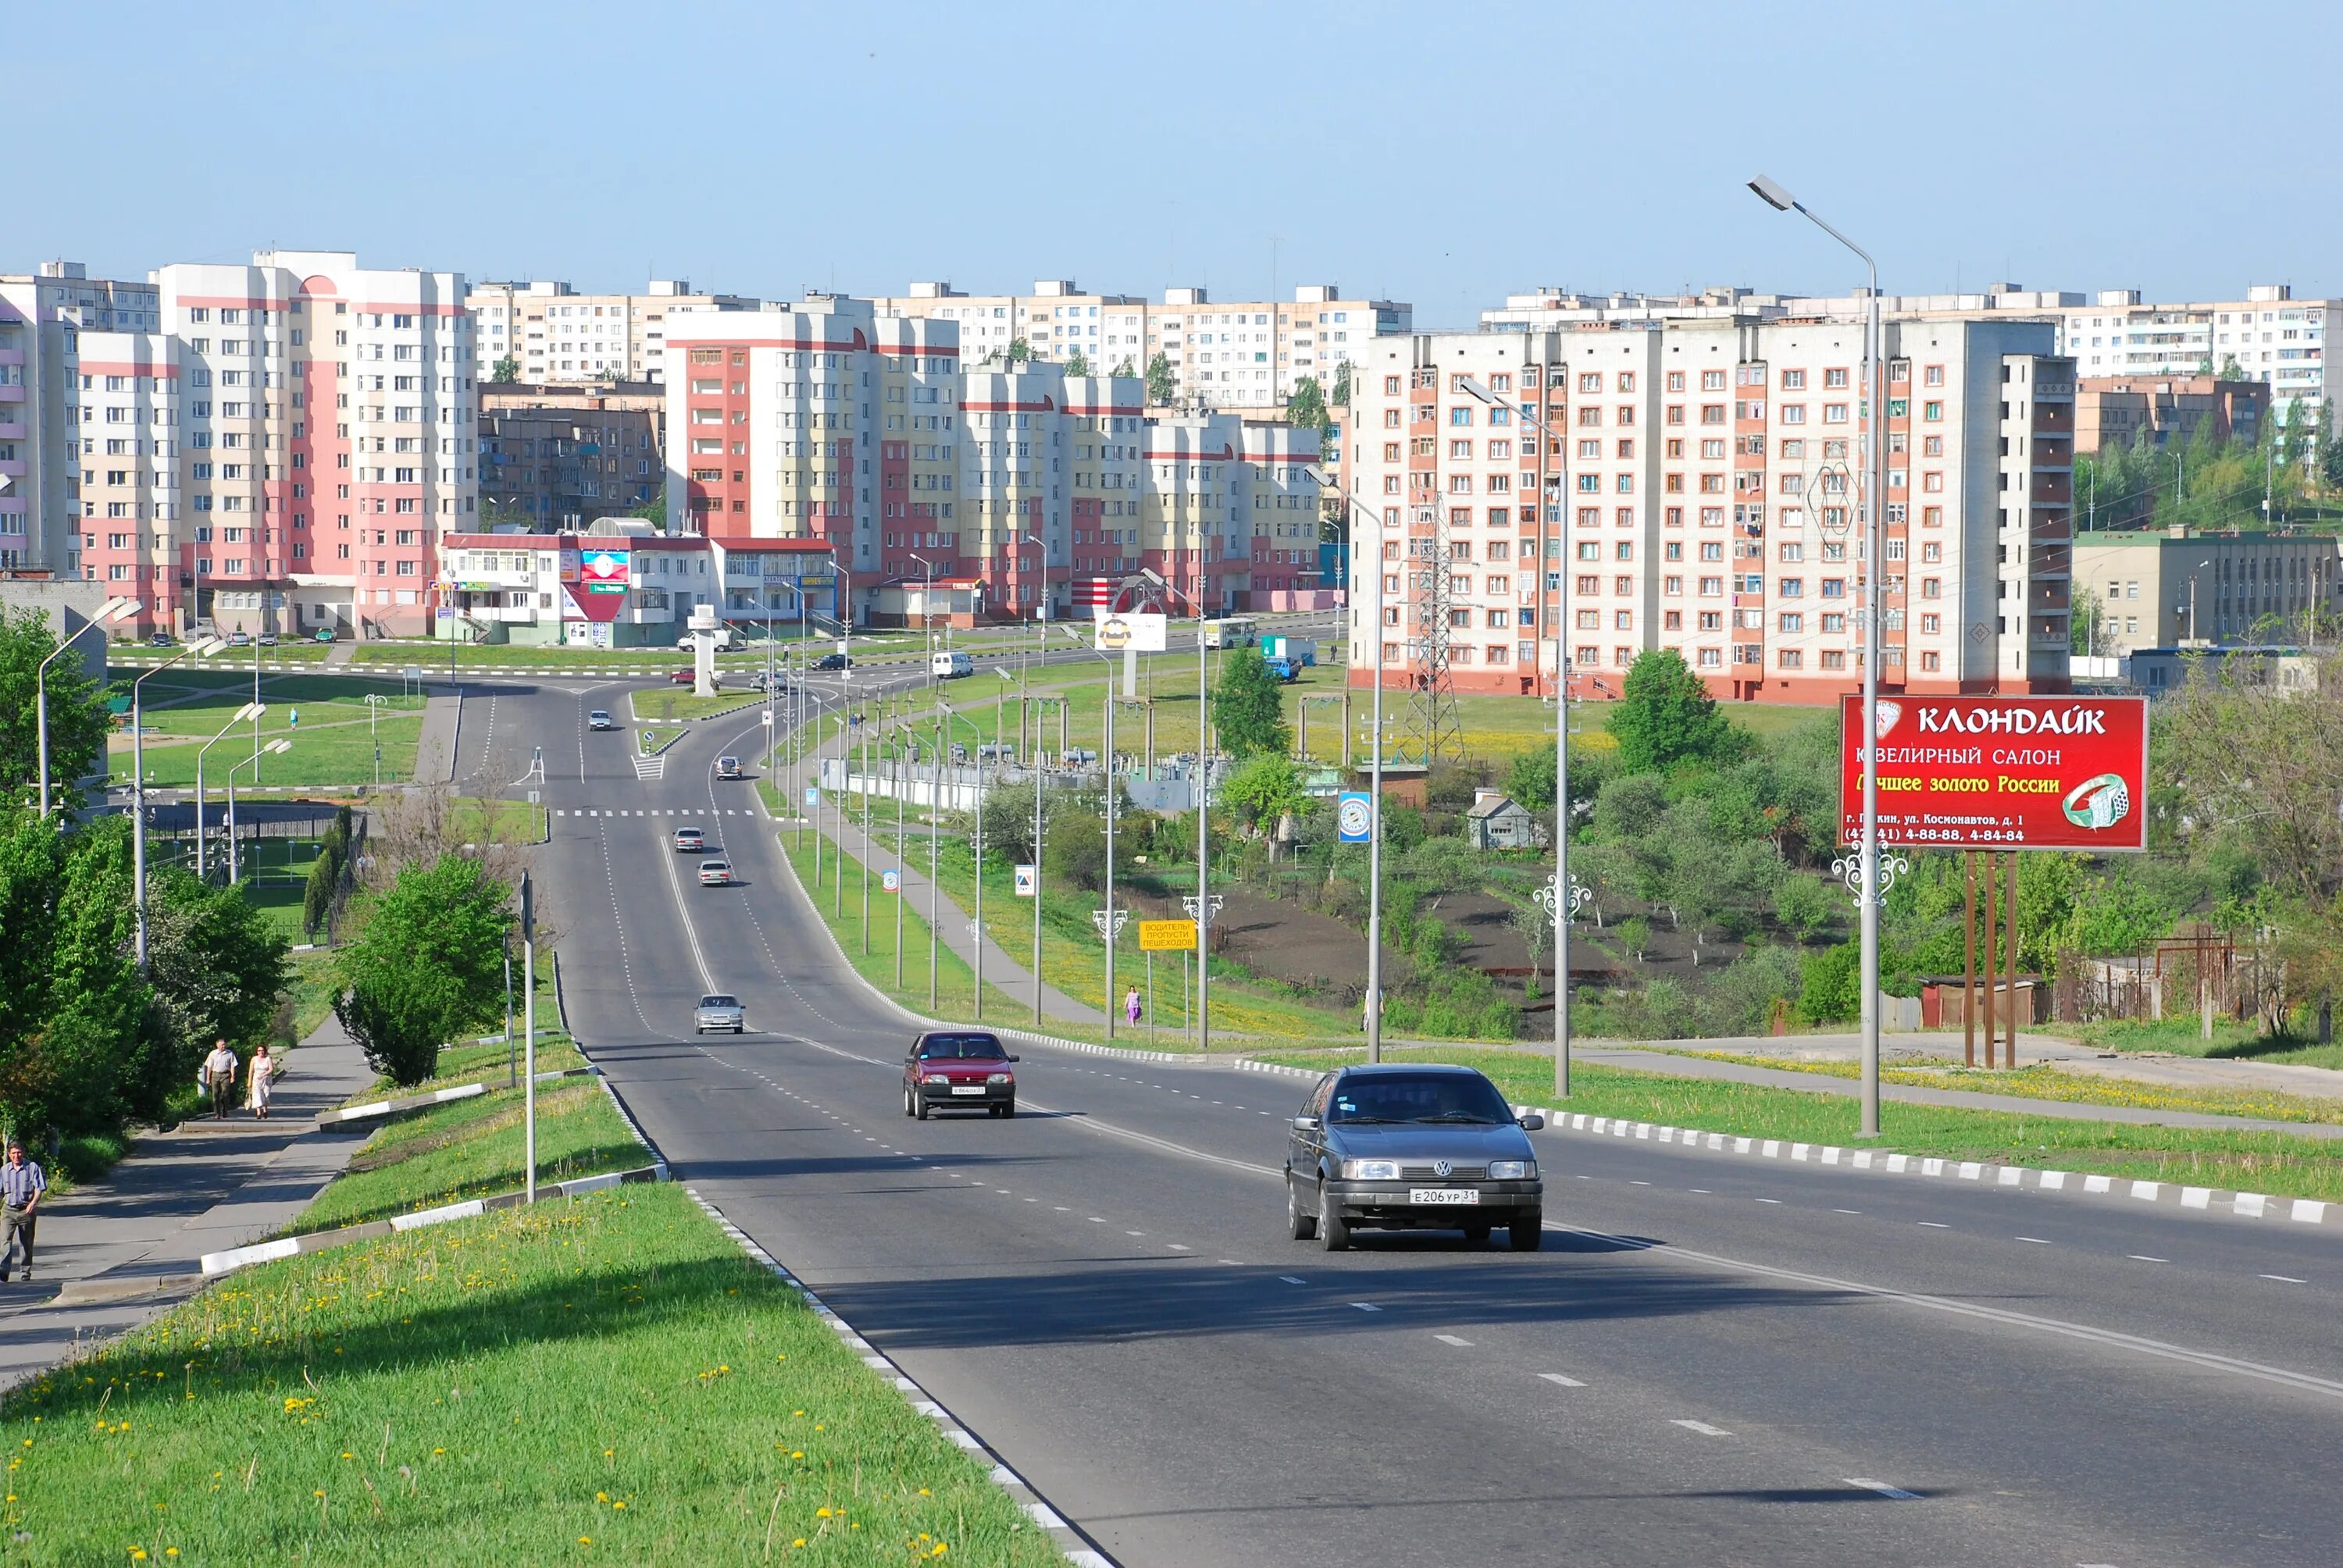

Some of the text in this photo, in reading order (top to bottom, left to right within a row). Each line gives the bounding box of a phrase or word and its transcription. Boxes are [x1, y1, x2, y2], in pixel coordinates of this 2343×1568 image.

[1992, 750, 2061, 765] САЛОН
[1856, 774, 2060, 793] Лчшее золото России
[1904, 814, 1919, 825] ул.
[1924, 814, 1999, 826] Космонавтов,
[2002, 815, 2013, 825] д.
[2018, 815, 2024, 825] 1
[1846, 828, 2024, 842] (4741) 4-88-88, 4-84-84
